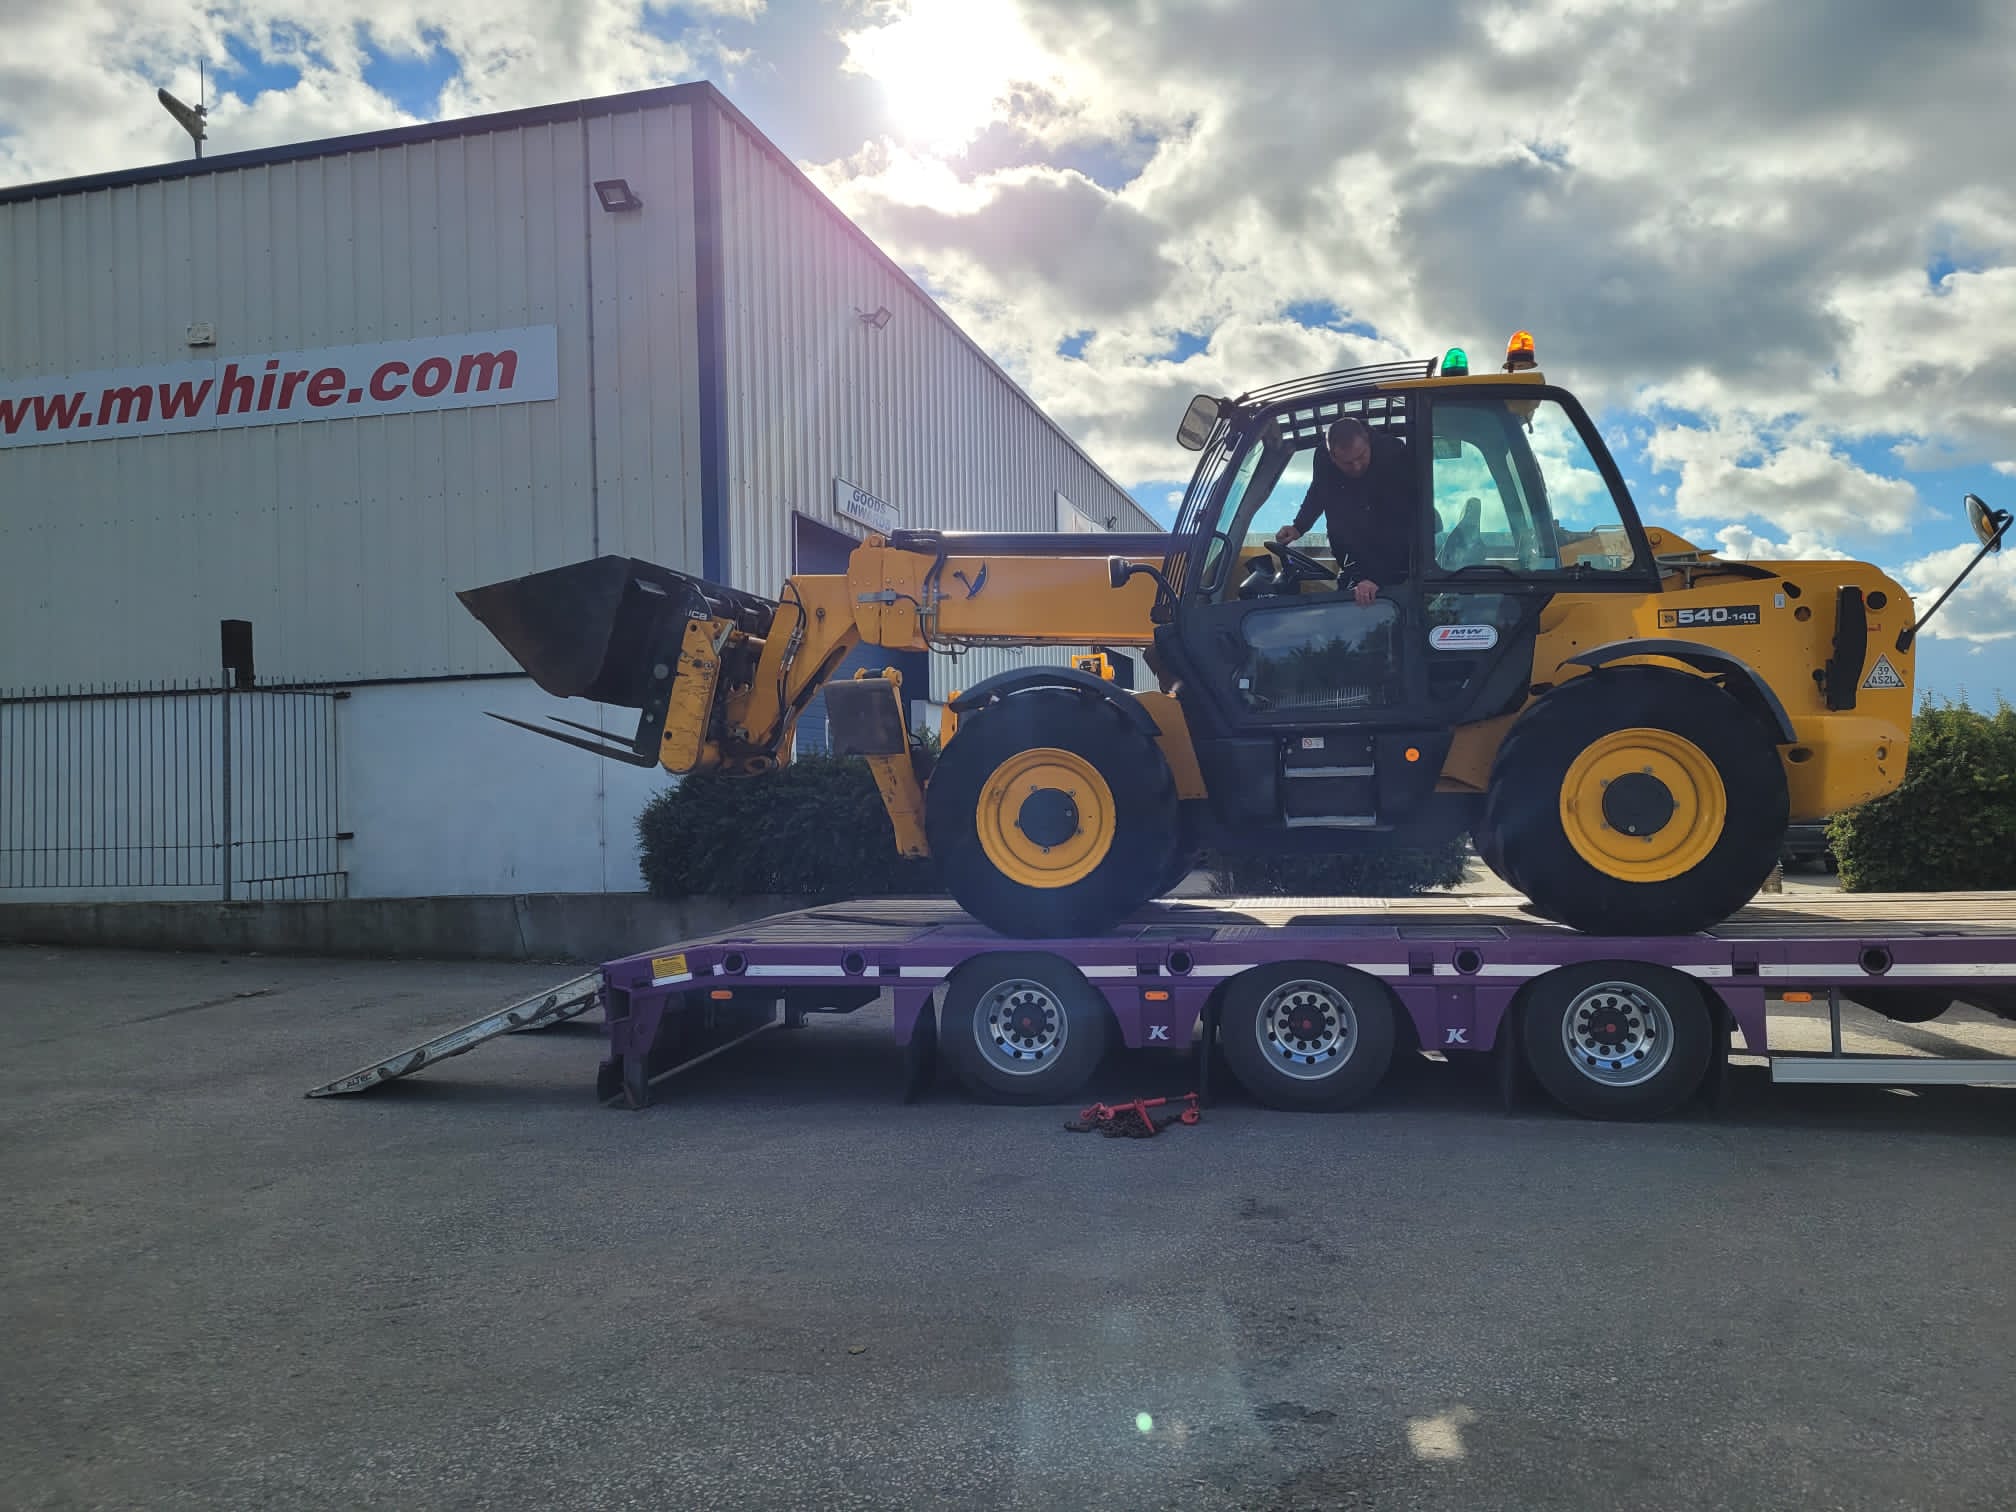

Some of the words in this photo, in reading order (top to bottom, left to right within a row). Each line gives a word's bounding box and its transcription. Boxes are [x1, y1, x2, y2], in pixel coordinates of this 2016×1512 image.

[853, 489, 887, 513] GOODS
[1878, 667, 1890, 675] 39
[1148, 1025, 1169, 1040] K
[1444, 1028, 1469, 1043] K
